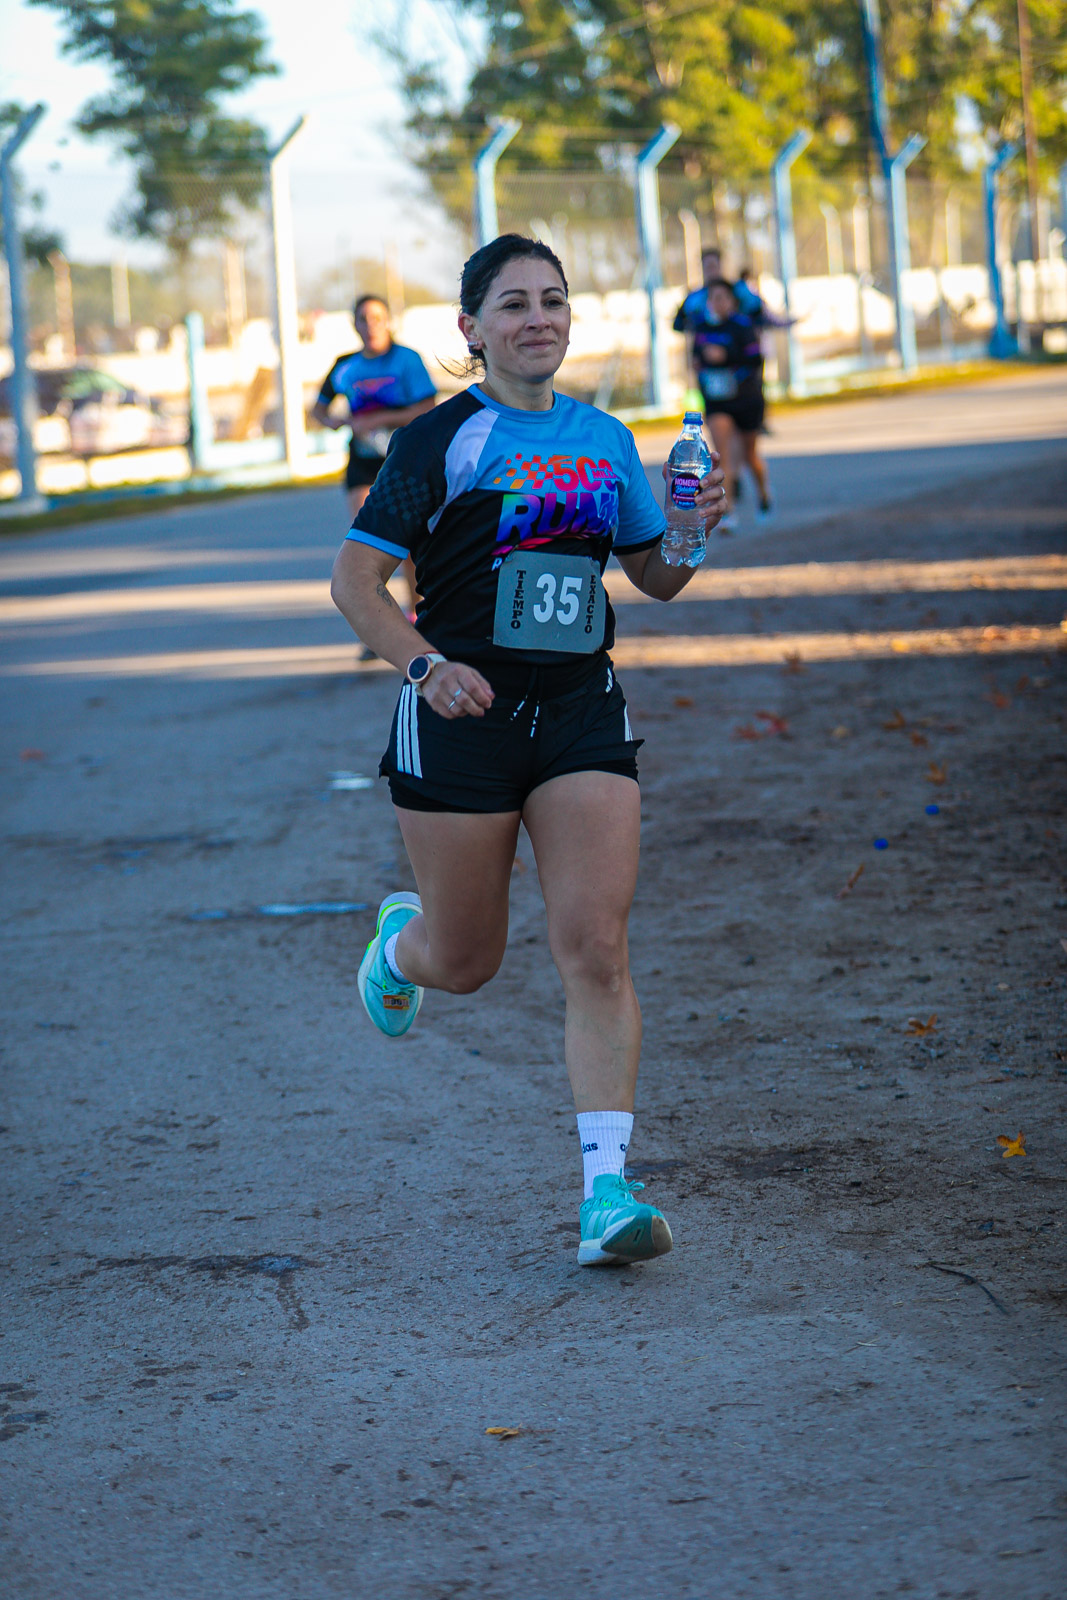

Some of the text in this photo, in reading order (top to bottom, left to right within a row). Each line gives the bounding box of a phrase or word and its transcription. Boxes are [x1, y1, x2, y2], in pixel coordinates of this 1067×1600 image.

[511, 570, 527, 630] TIEMPO
[533, 573, 583, 626] 35
[584, 575, 597, 634] EXACTO
